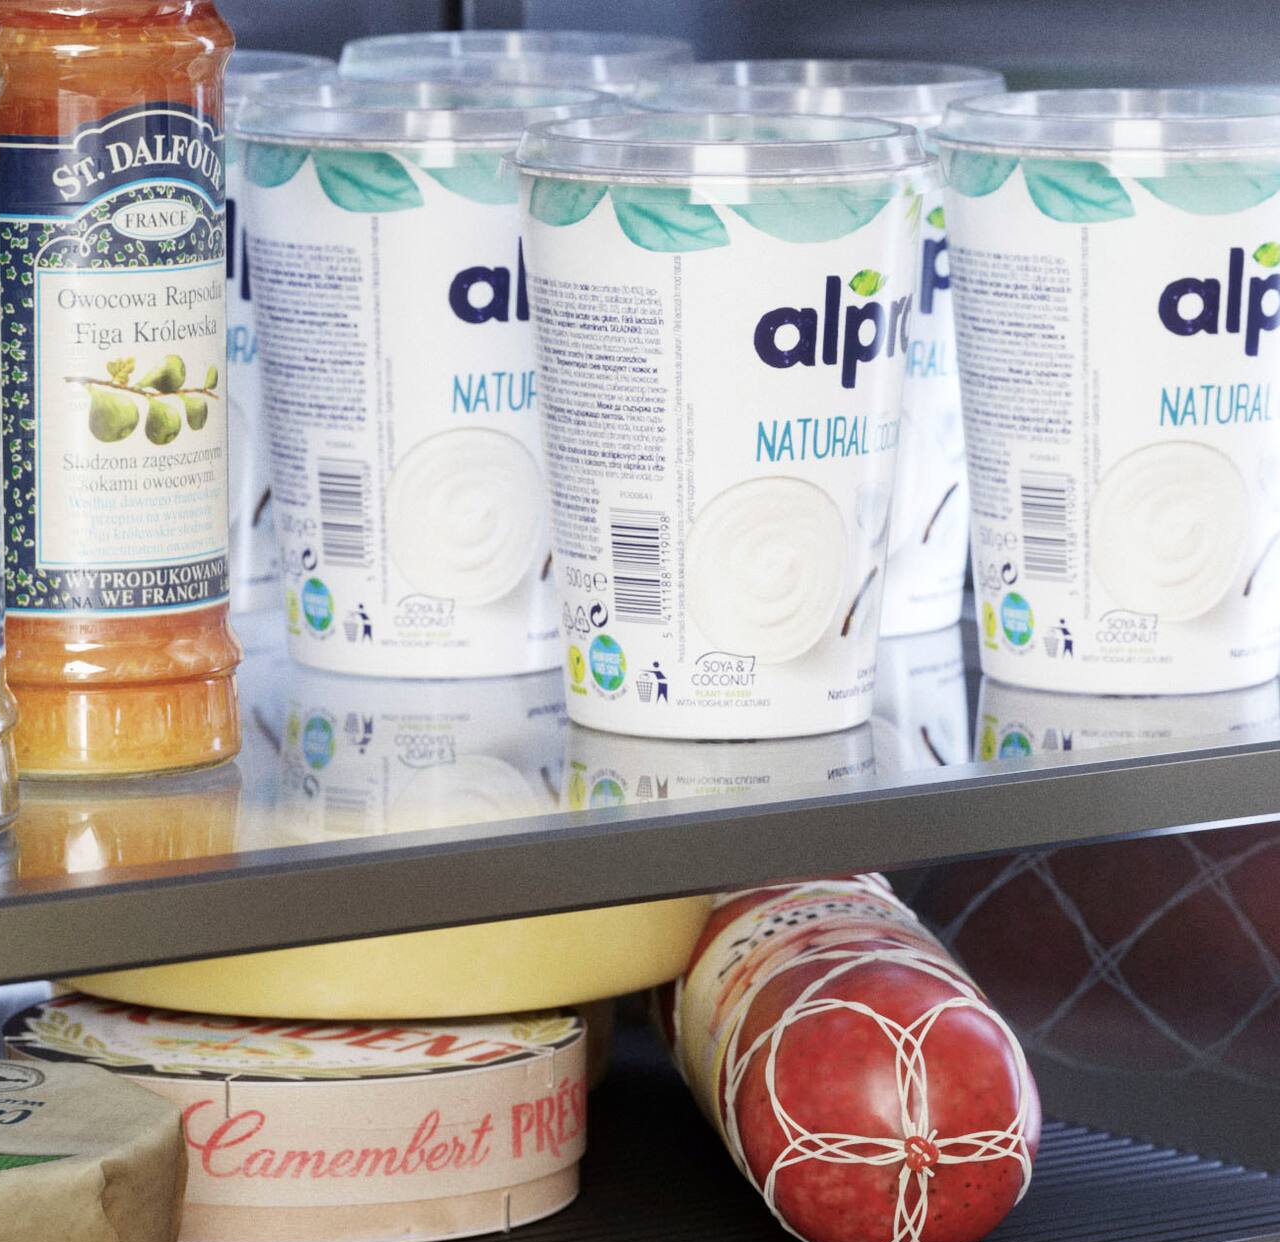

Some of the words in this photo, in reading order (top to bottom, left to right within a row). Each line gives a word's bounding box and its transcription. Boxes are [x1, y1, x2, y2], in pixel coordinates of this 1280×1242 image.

[52, 156, 105, 200] ST.
[106, 134, 222, 191] DALFOUR
[125, 209, 189, 228] FRANCE
[57, 288, 157, 310] Owocowa
[75, 321, 122, 350] Figa
[133, 315, 218, 343] Królewska
[1159, 384, 1272, 427] NATURAL
[755, 415, 871, 462] NATURAL
[65, 561, 225, 589] WYPRODUKOWANO
[102, 589, 134, 607] WE
[142, 582, 209, 606] FRANCJI
[691, 673, 756, 687] COCONUT
[703, 660, 733, 673] SOYA
[735, 659, 746, 673] &
[181, 1099, 494, 1179] Camembert
